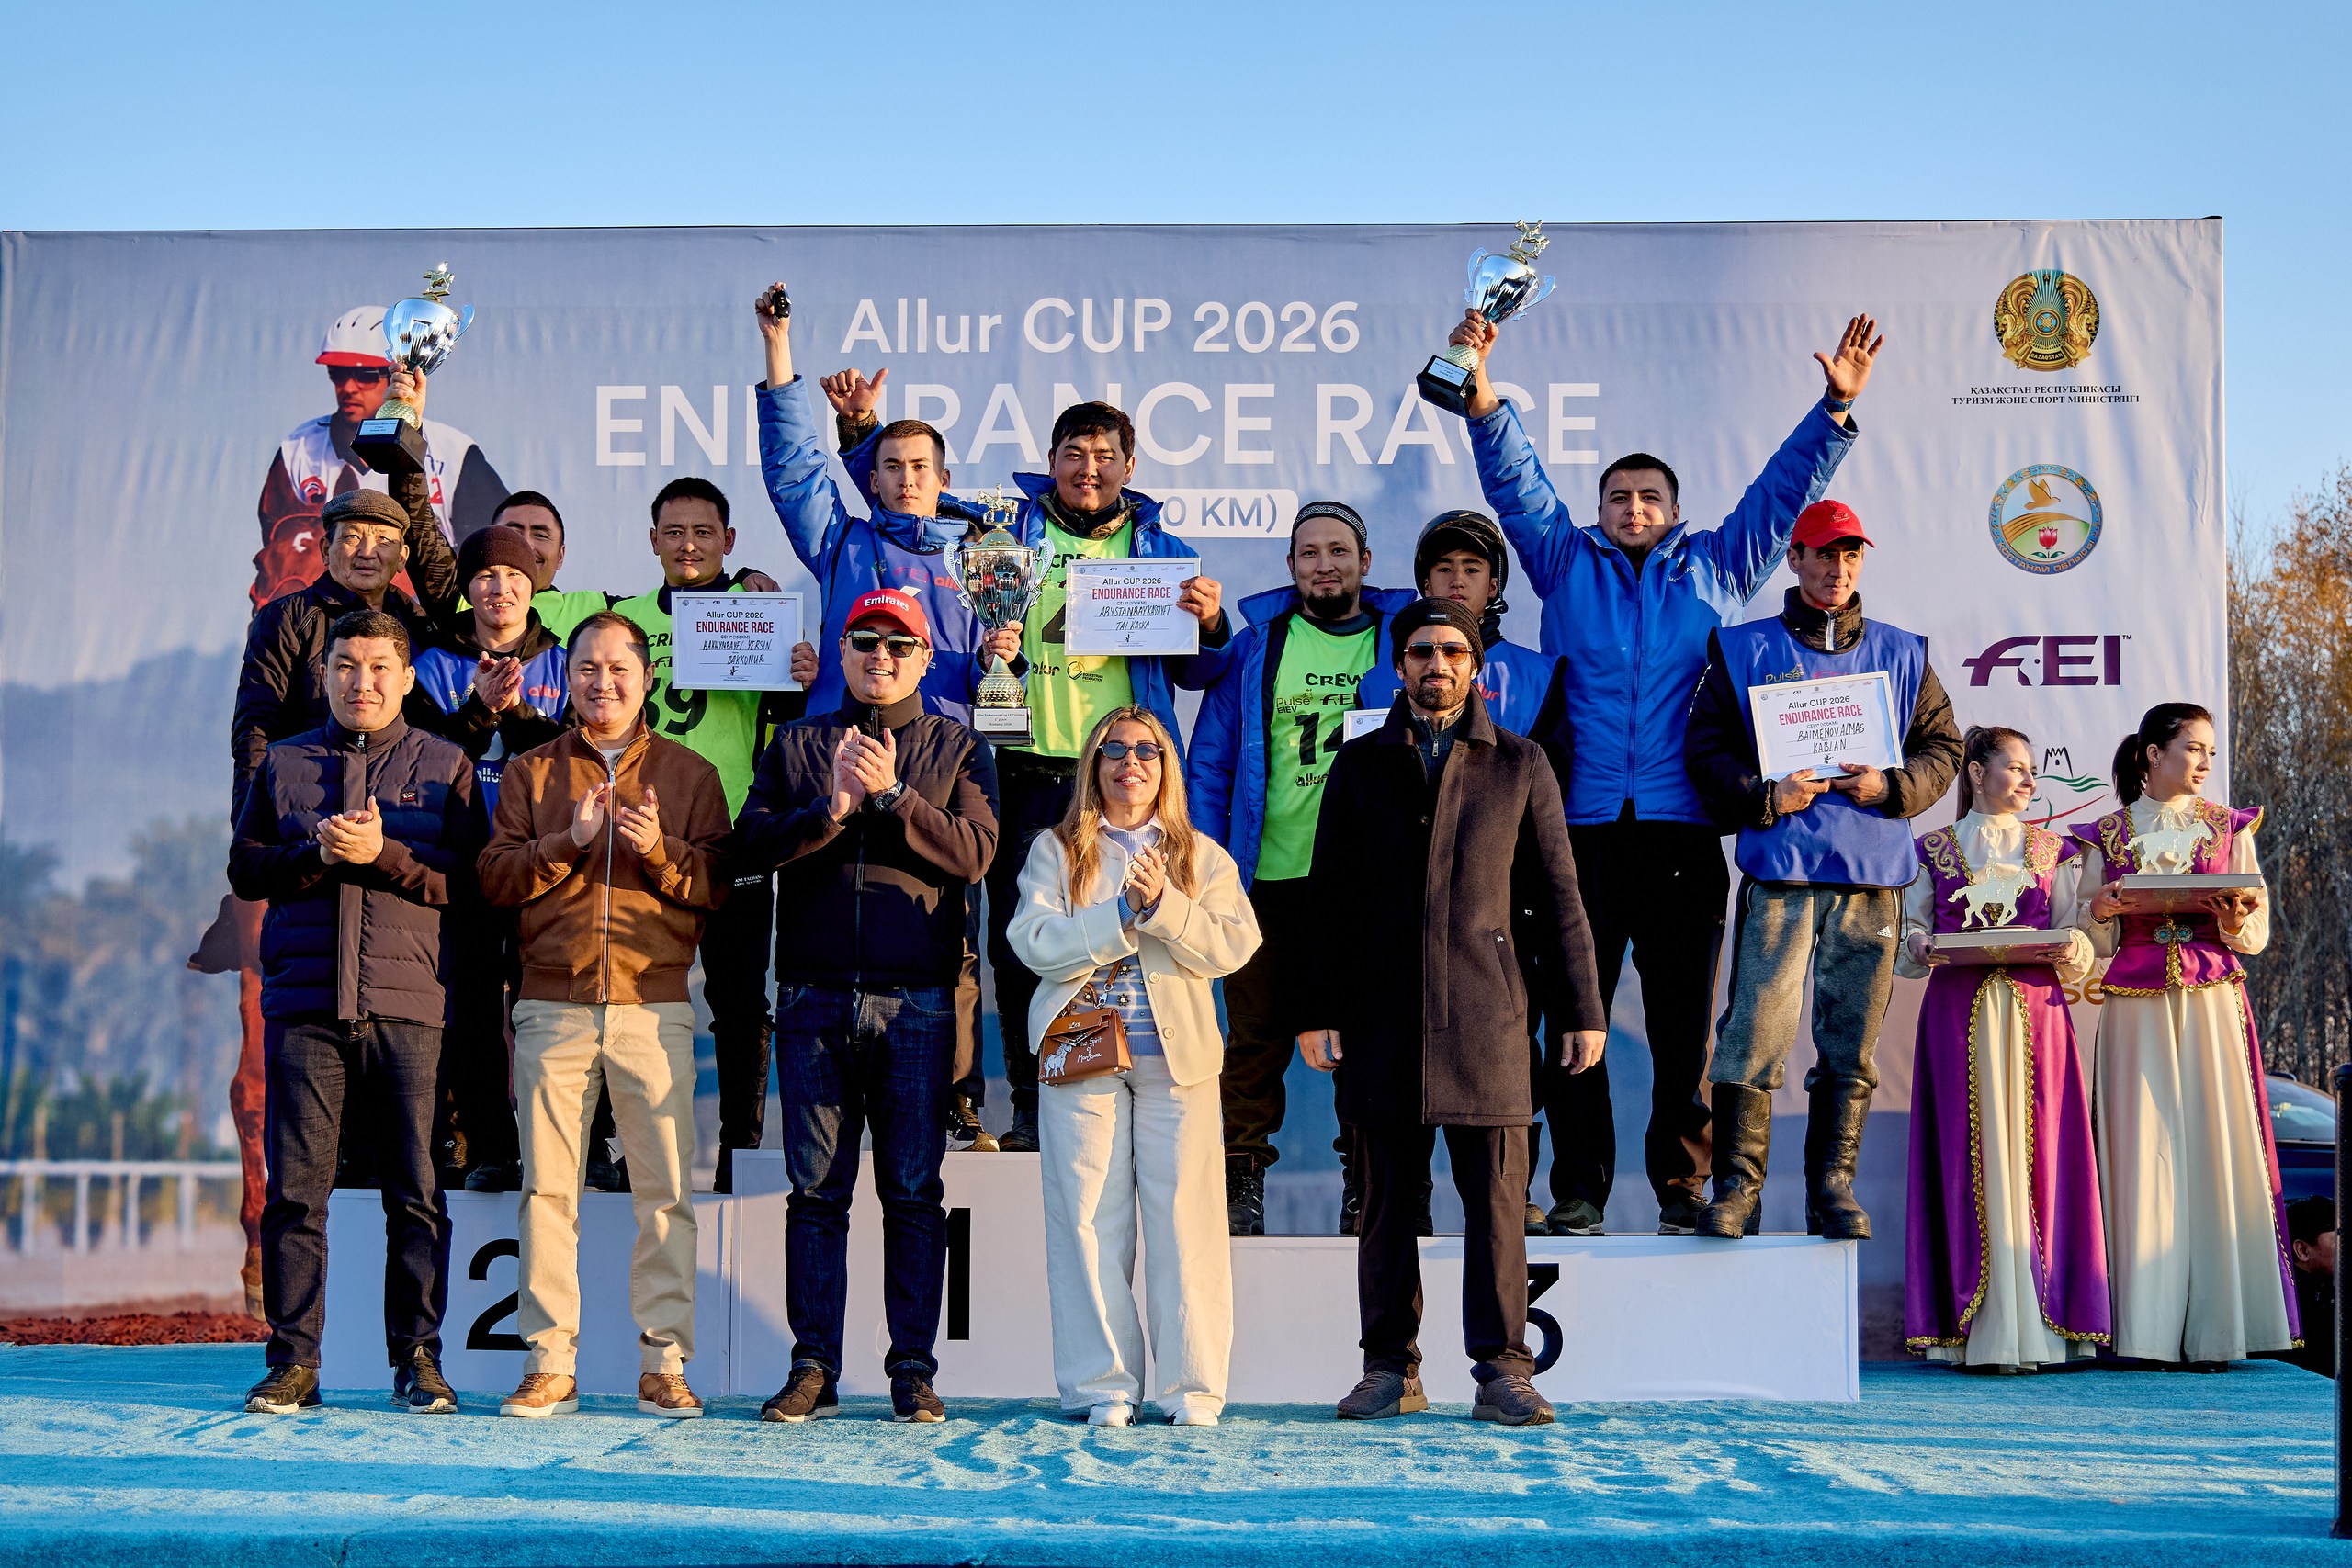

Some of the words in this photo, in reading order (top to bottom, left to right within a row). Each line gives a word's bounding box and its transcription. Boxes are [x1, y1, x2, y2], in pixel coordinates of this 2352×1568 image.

[841, 298, 1002, 354] Allur
[1023, 297, 1172, 354] CUP
[1193, 300, 1360, 354] 2026
[1971, 386, 2031, 395] ҚАЗАҚСТАН
[2034, 385, 2121, 394] РЕСПУБЛИКАСЫ
[1952, 397, 1994, 405] ТУРИЗМ
[1996, 396, 2028, 404] ЖӘНЕ
[2030, 395, 2065, 404] СПОРТ
[2067, 395, 2140, 403] МИНИСТРЛІГІ
[595, 382, 1275, 467] ENRACE
[1201, 493, 1278, 534] KM)
[1102, 578, 1121, 586] Allur
[1142, 577, 1162, 585] 2026
[1092, 587, 1146, 600] ENDURANCE
[1148, 586, 1171, 599] RACE
[864, 595, 910, 612] Emirates
[706, 611, 724, 619] Allur
[726, 611, 743, 619] CUP
[696, 621, 749, 633] ENDURANCE
[751, 621, 774, 633] RACE
[1962, 635, 2120, 687] FEI
[1765, 671, 1801, 685] Pulse
[1276, 696, 1311, 707] Pulse
[1788, 700, 1808, 710] Allur
[1809, 697, 1828, 707] CUP
[1829, 695, 1850, 705] 2026
[1779, 707, 1836, 726] ENDURANCE
[1838, 704, 1863, 718] RACE
[1796, 728, 1840, 742] BAIMENOV
[1839, 722, 1865, 736] ALMAS
[1813, 738, 1848, 754] KABLAN
